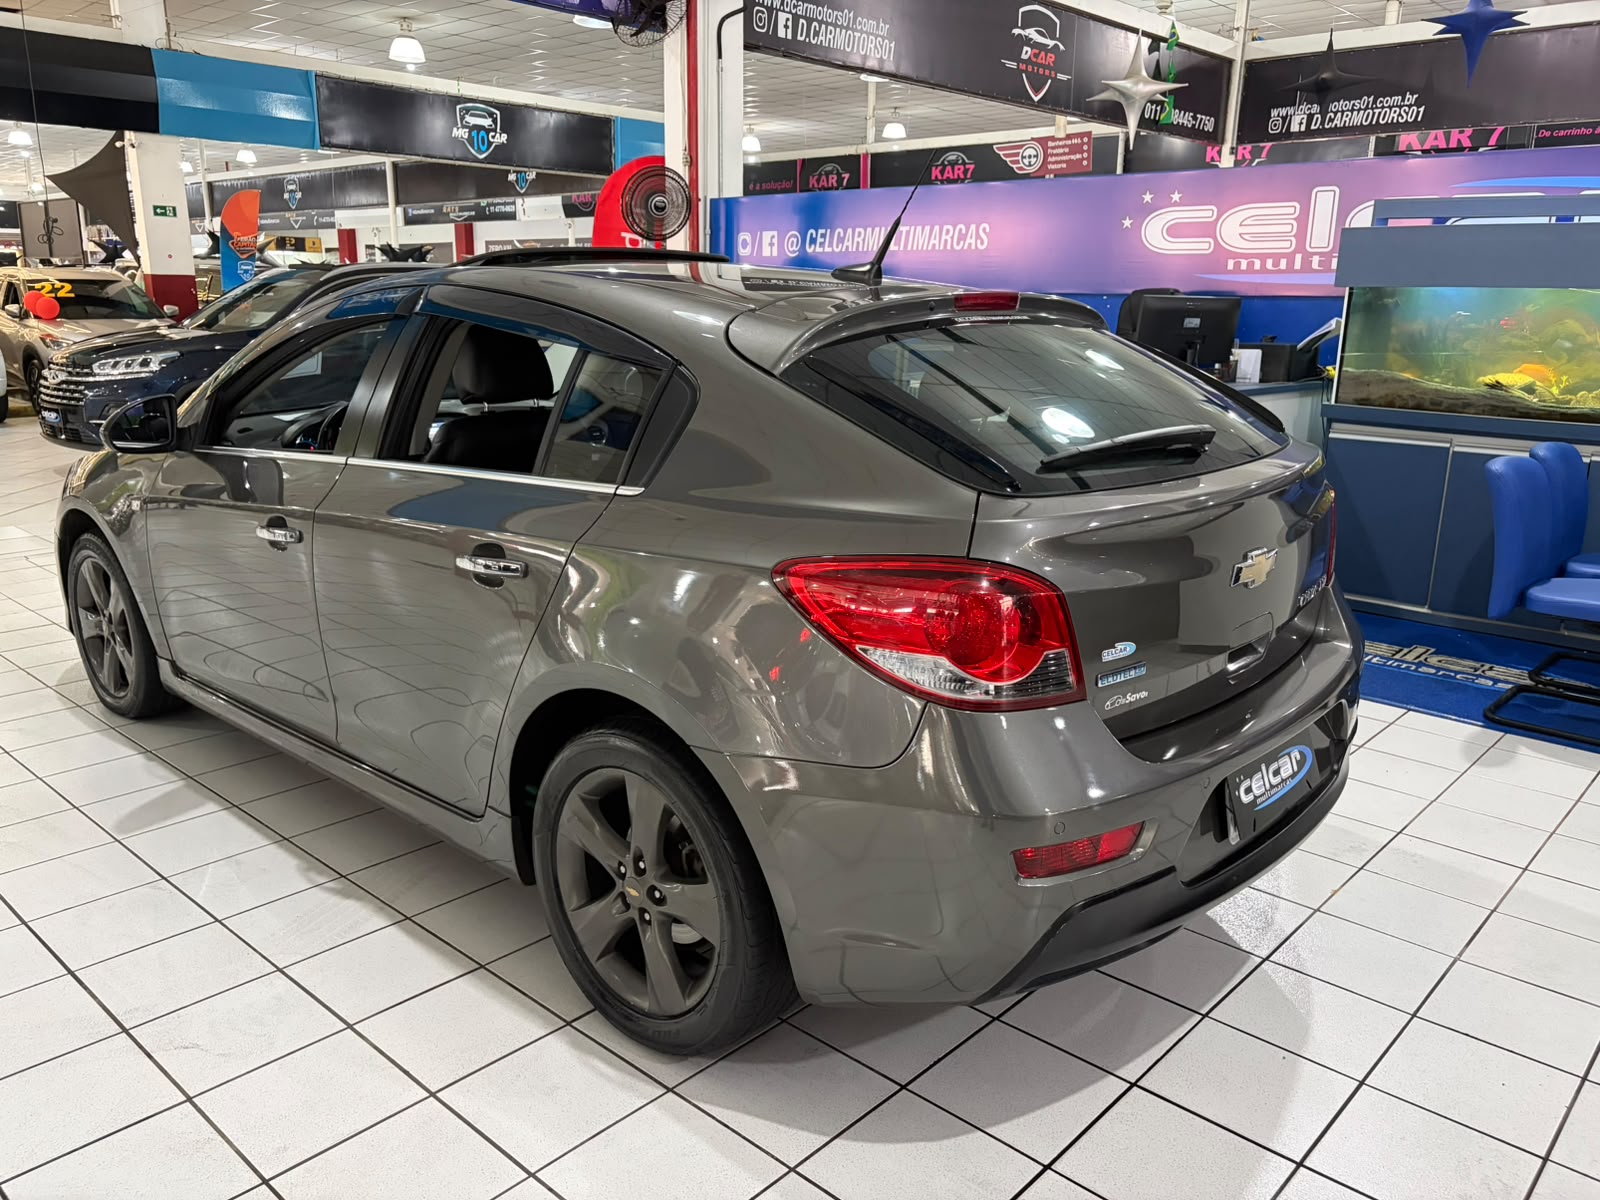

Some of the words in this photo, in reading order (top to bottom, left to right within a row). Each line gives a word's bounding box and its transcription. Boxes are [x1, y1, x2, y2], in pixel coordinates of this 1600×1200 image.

[755, 0, 890, 36] ww.dcarmotors01.com.br
[797, 18, 896, 61] D.CARMOTORS01
[1020, 46, 1056, 67] DCAR
[1019, 63, 1056, 78] MOTORS
[1270, 92, 1419, 118] www.dcarotors01.com.br
[1310, 105, 1426, 130] D.CARMOTORS01
[1171, 108, 1215, 133] 8445-7750
[1553, 127, 1593, 137] carrinho
[451, 127, 470, 139] MG
[471, 129, 488, 152] 10
[488, 132, 508, 144] CAR
[1398, 127, 1473, 151] KAR
[1205, 145, 1253, 163] KR
[809, 175, 838, 189] KAR
[841, 173, 851, 187] 7
[1239, 748, 1301, 805] celcar
